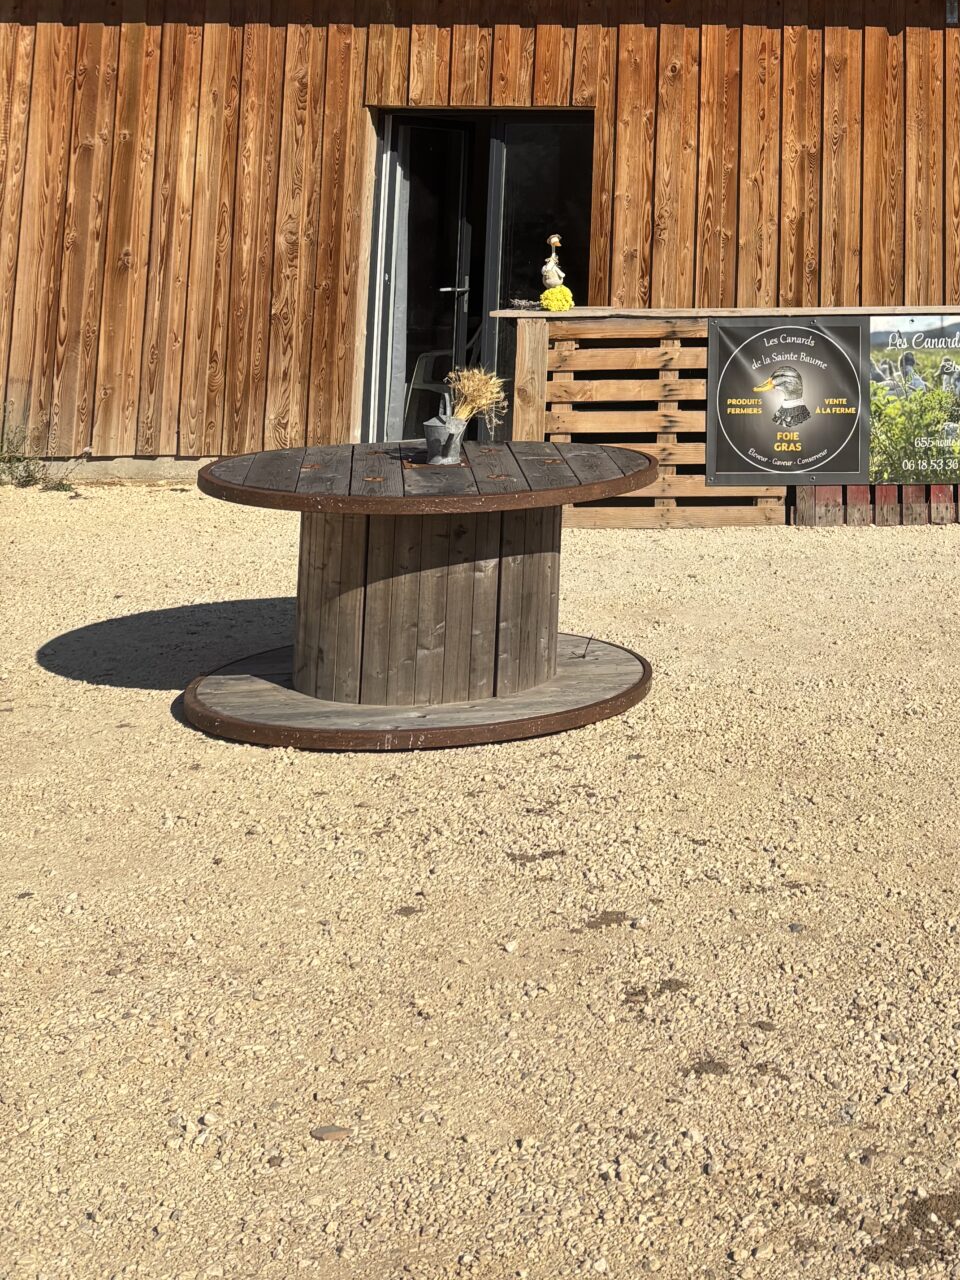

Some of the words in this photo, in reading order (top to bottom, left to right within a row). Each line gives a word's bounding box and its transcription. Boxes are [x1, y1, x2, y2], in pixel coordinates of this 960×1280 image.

[763, 337, 779, 347] Les
[780, 333, 815, 347] Canards
[887, 333, 909, 350] Les
[752, 358, 762, 370] de
[761, 355, 771, 365] la
[772, 351, 798, 362] Sainte
[800, 352, 828, 370] Baume
[777, 432, 800, 441] FOIE
[914, 437, 934, 448] 655
[774, 443, 802, 451] GRAS
[772, 458, 793, 466] Gaveur
[797, 448, 828, 465] Conserveur
[902, 459, 915, 470] 06
[918, 459, 928, 470] 18
[930, 459, 944, 470] 53
[945, 458, 959, 470] 36
